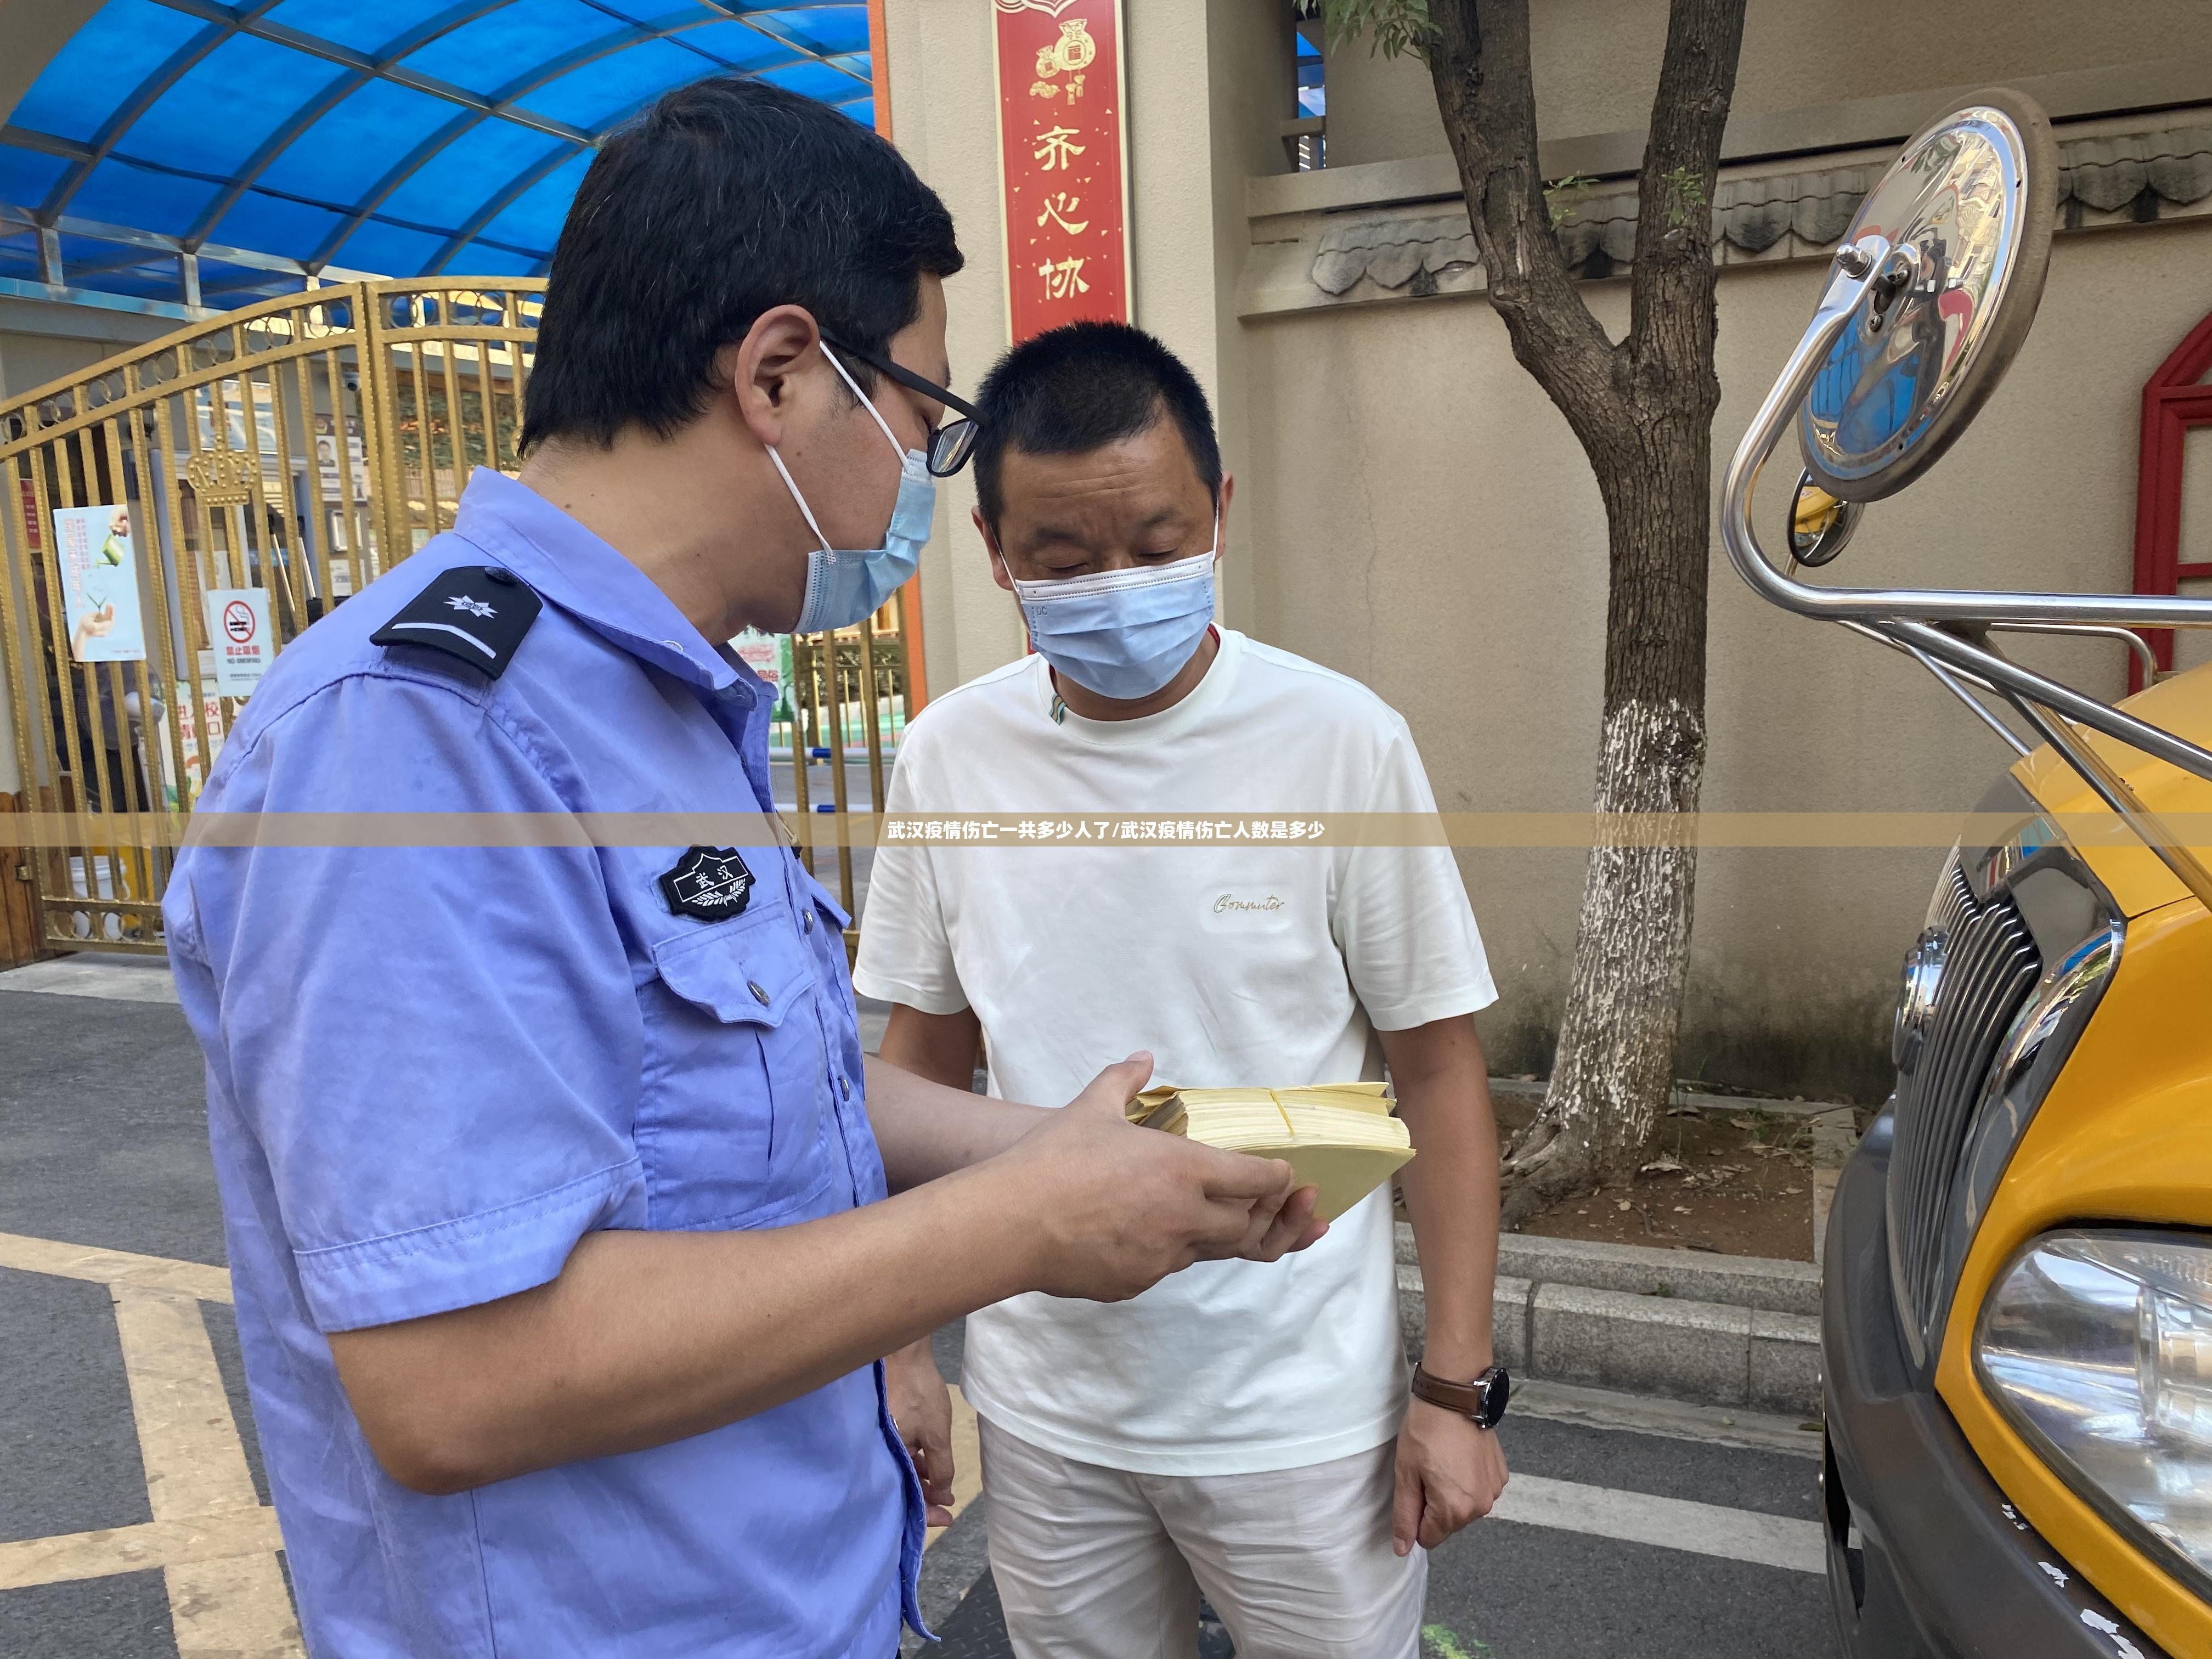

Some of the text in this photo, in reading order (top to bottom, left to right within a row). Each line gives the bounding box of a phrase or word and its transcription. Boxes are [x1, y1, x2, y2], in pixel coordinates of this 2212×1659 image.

[1035, 126, 1091, 300] 齐心协
[696, 865, 733, 889] 武汉
